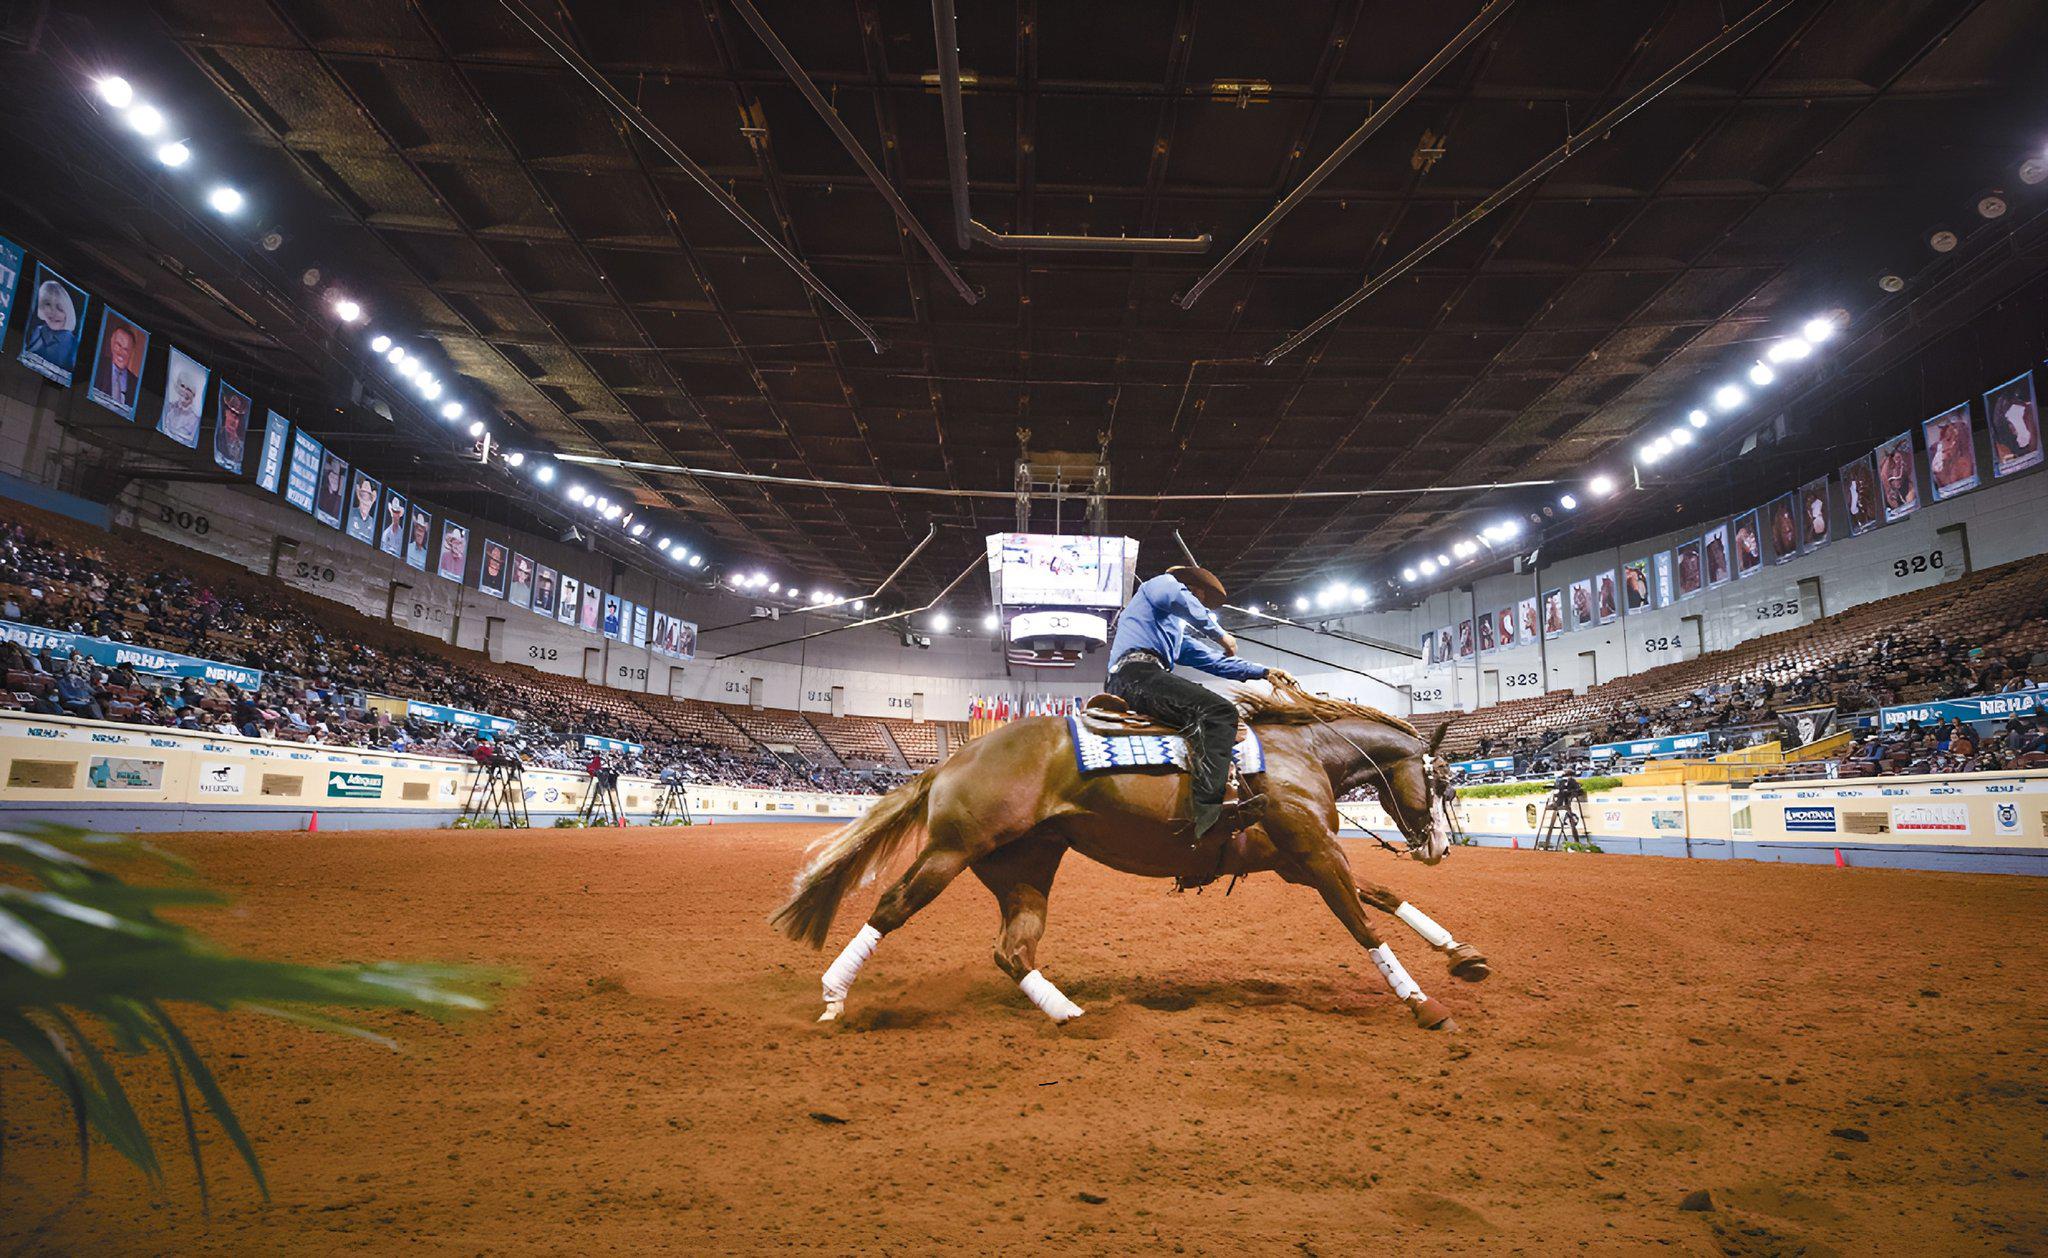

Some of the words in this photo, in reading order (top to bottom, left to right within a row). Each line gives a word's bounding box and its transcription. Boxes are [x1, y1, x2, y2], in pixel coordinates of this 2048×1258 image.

[160, 505, 209, 535] 309
[1894, 551, 1944, 577] 326
[1757, 600, 1799, 619] 325
[1645, 635, 1682, 652] 324
[116, 649, 165, 668] NRHA
[529, 646, 558, 661] 312
[619, 666, 646, 680] 313
[1506, 672, 1538, 687] 323
[1413, 689, 1442, 701] 322
[1979, 696, 2035, 714] NRHA
